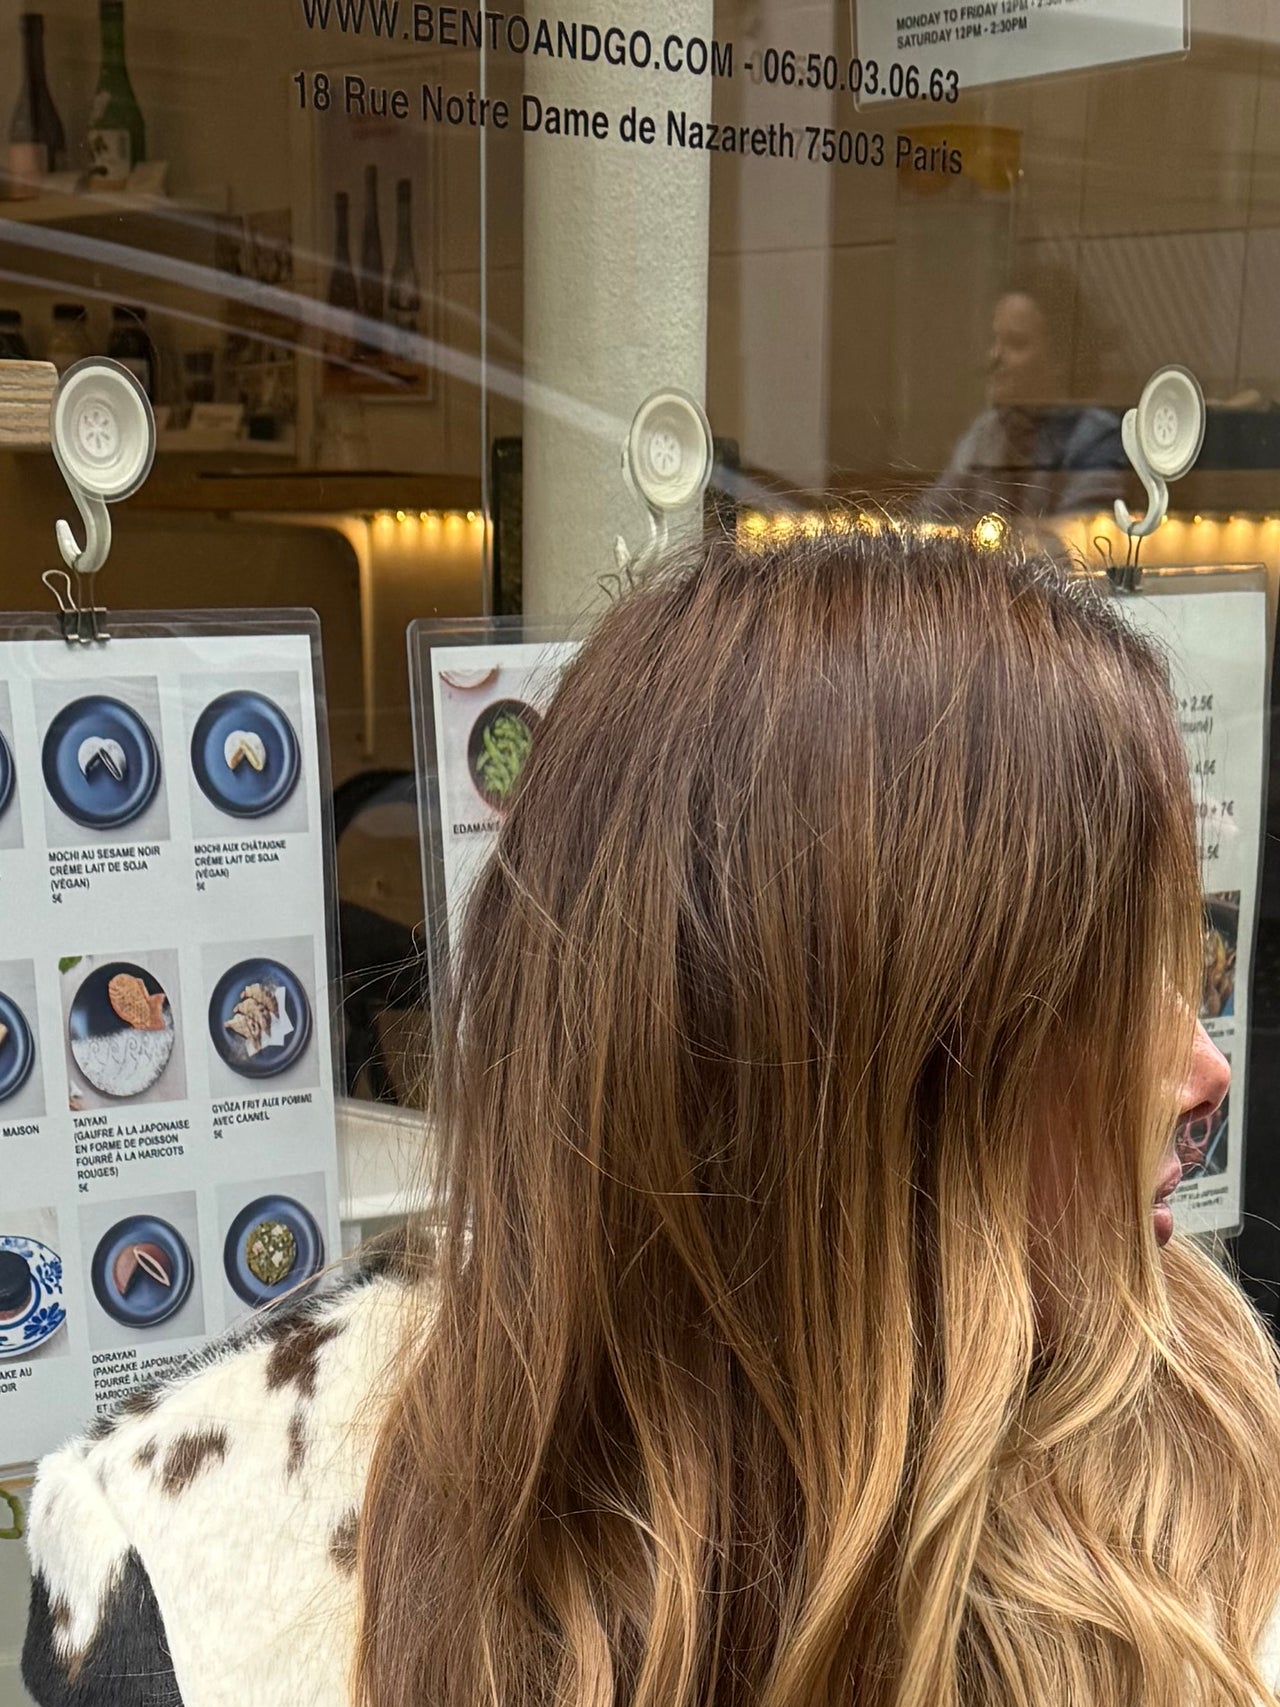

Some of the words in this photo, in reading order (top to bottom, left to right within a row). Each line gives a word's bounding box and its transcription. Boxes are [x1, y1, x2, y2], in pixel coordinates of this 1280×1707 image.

[897, 12, 941, 31] MONDAY
[944, 8, 958, 22] TO
[960, 3, 997, 21] FRIDAY
[897, 29, 952, 50] SATURDAY
[955, 24, 982, 41] 12PM
[990, 16, 1027, 35] 2:30PM
[302, 0, 733, 78] WWW.BENTOANDGO.COM
[763, 48, 960, 104] 06.50.03.06.63
[294, 71, 331, 112] 18
[344, 75, 410, 120] Rue
[421, 83, 509, 129] Notre
[522, 94, 609, 140] Dame
[619, 106, 656, 145] de
[667, 109, 794, 158] Nazareth
[805, 126, 885, 167] 75003
[896, 135, 963, 175] Paris
[48, 850, 80, 862] MOCHI
[81, 849, 95, 860] AU
[138, 845, 161, 857] NOIR
[194, 844, 221, 855] MOCHI
[85, 862, 106, 874] LAIT
[107, 861, 121, 872] DE
[123, 860, 148, 872] SOJA
[225, 854, 243, 865] LAIT
[244, 853, 256, 864] DE
[50, 878, 90, 892] (VÉGAN)
[73, 1115, 108, 1128] TAIYAKI
[2, 1124, 40, 1137] MAISON
[73, 1127, 114, 1143] (GAUFRE
[125, 1125, 138, 1136] LA
[139, 1119, 190, 1134] JAPONAISE
[75, 1145, 88, 1155] EN
[89, 1139, 122, 1153] FORME
[124, 1138, 137, 1149] DE
[138, 1133, 179, 1147] POISSON
[124, 1150, 137, 1161] LA
[138, 1145, 185, 1160] HARICOTS
[77, 1166, 119, 1180] ROUGES)
[91, 1349, 137, 1365] DORAYAKI
[19, 1366, 33, 1378] AU
[93, 1361, 138, 1378] (PANCAKE
